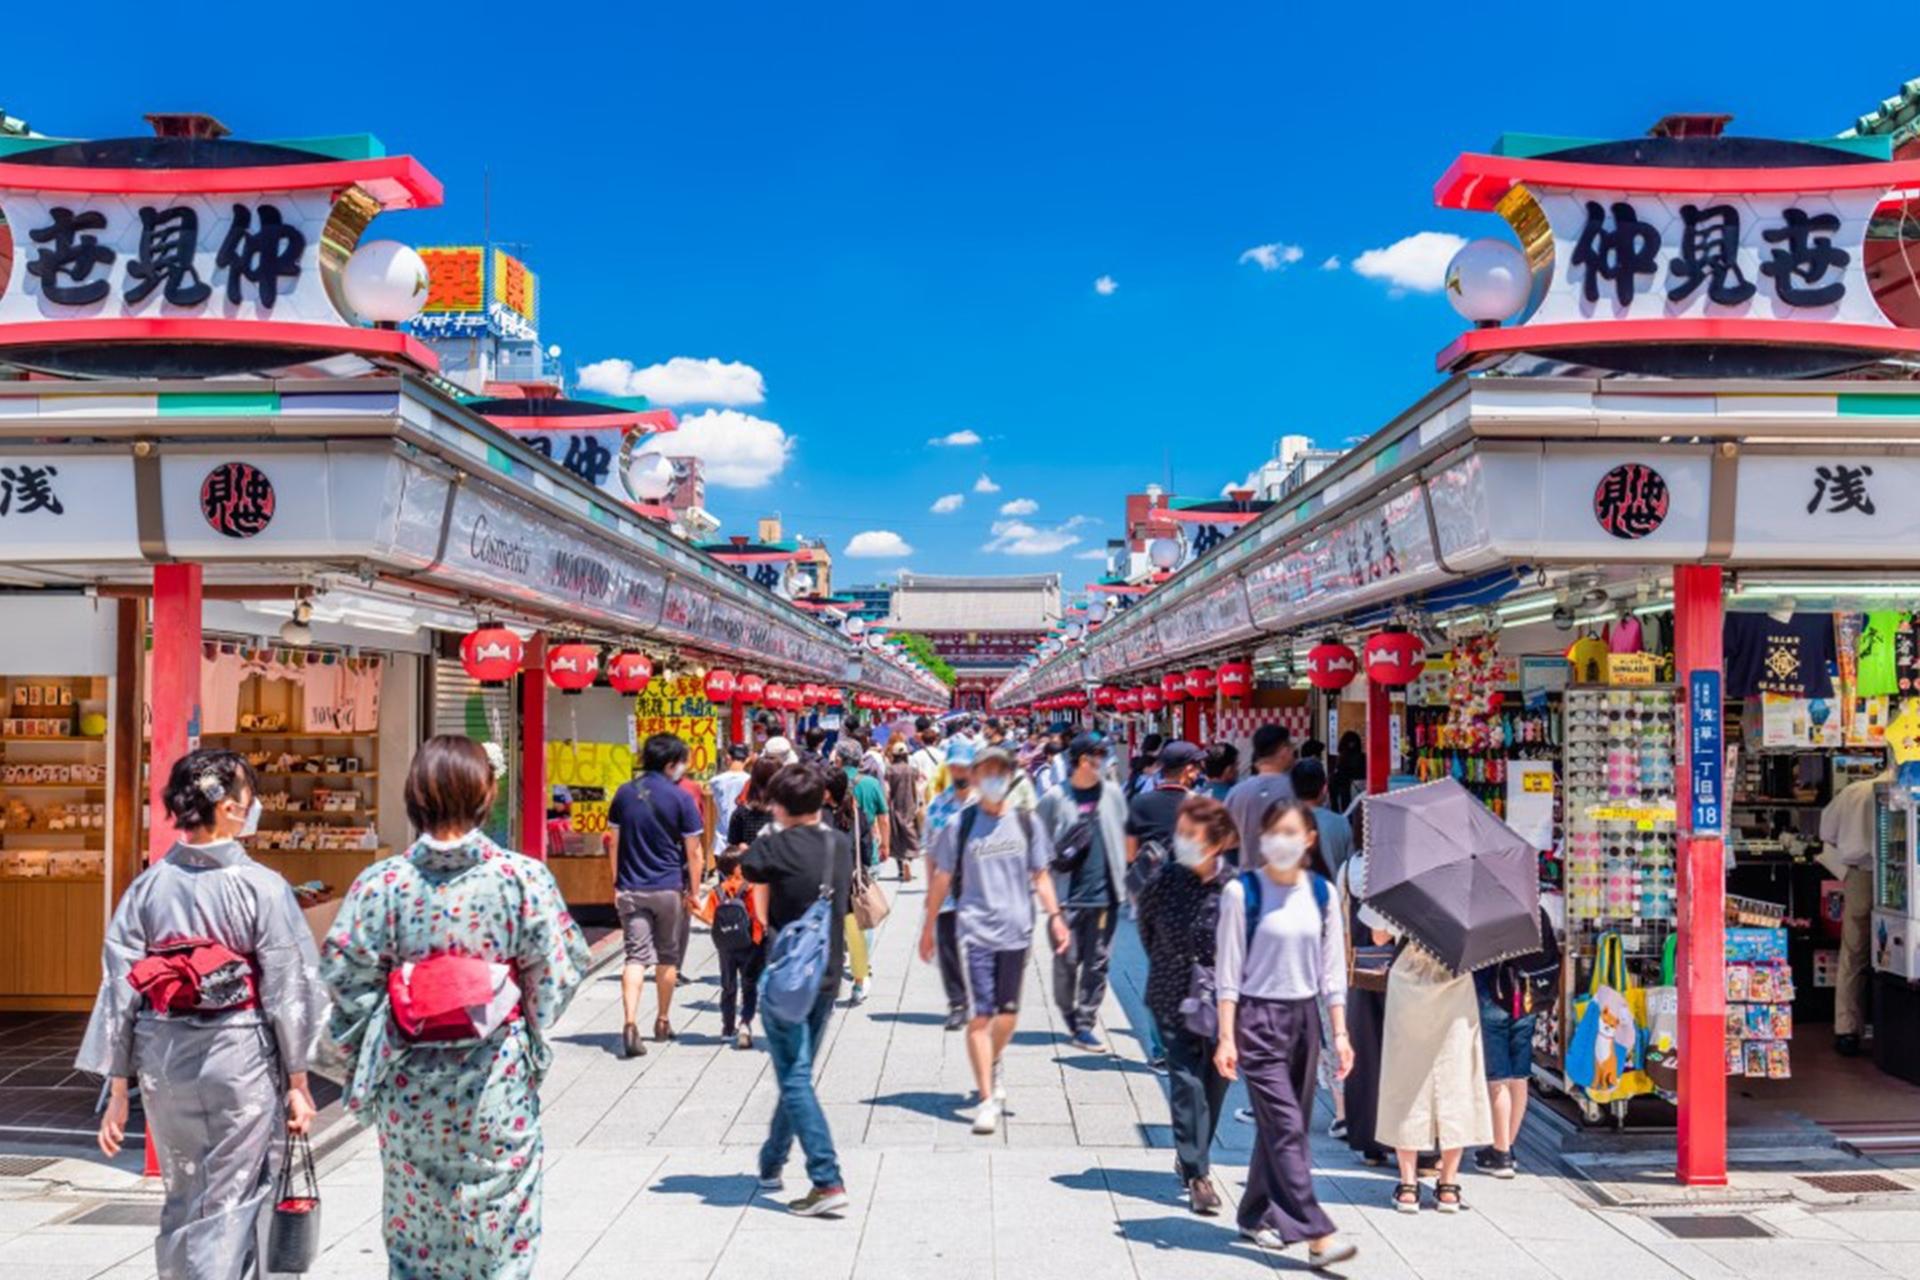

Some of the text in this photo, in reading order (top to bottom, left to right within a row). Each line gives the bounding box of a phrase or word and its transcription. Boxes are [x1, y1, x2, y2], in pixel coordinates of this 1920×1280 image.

[0, 465, 64, 516] 浅
[1807, 465, 1876, 515] 浅
[1697, 806, 1717, 825] 18
